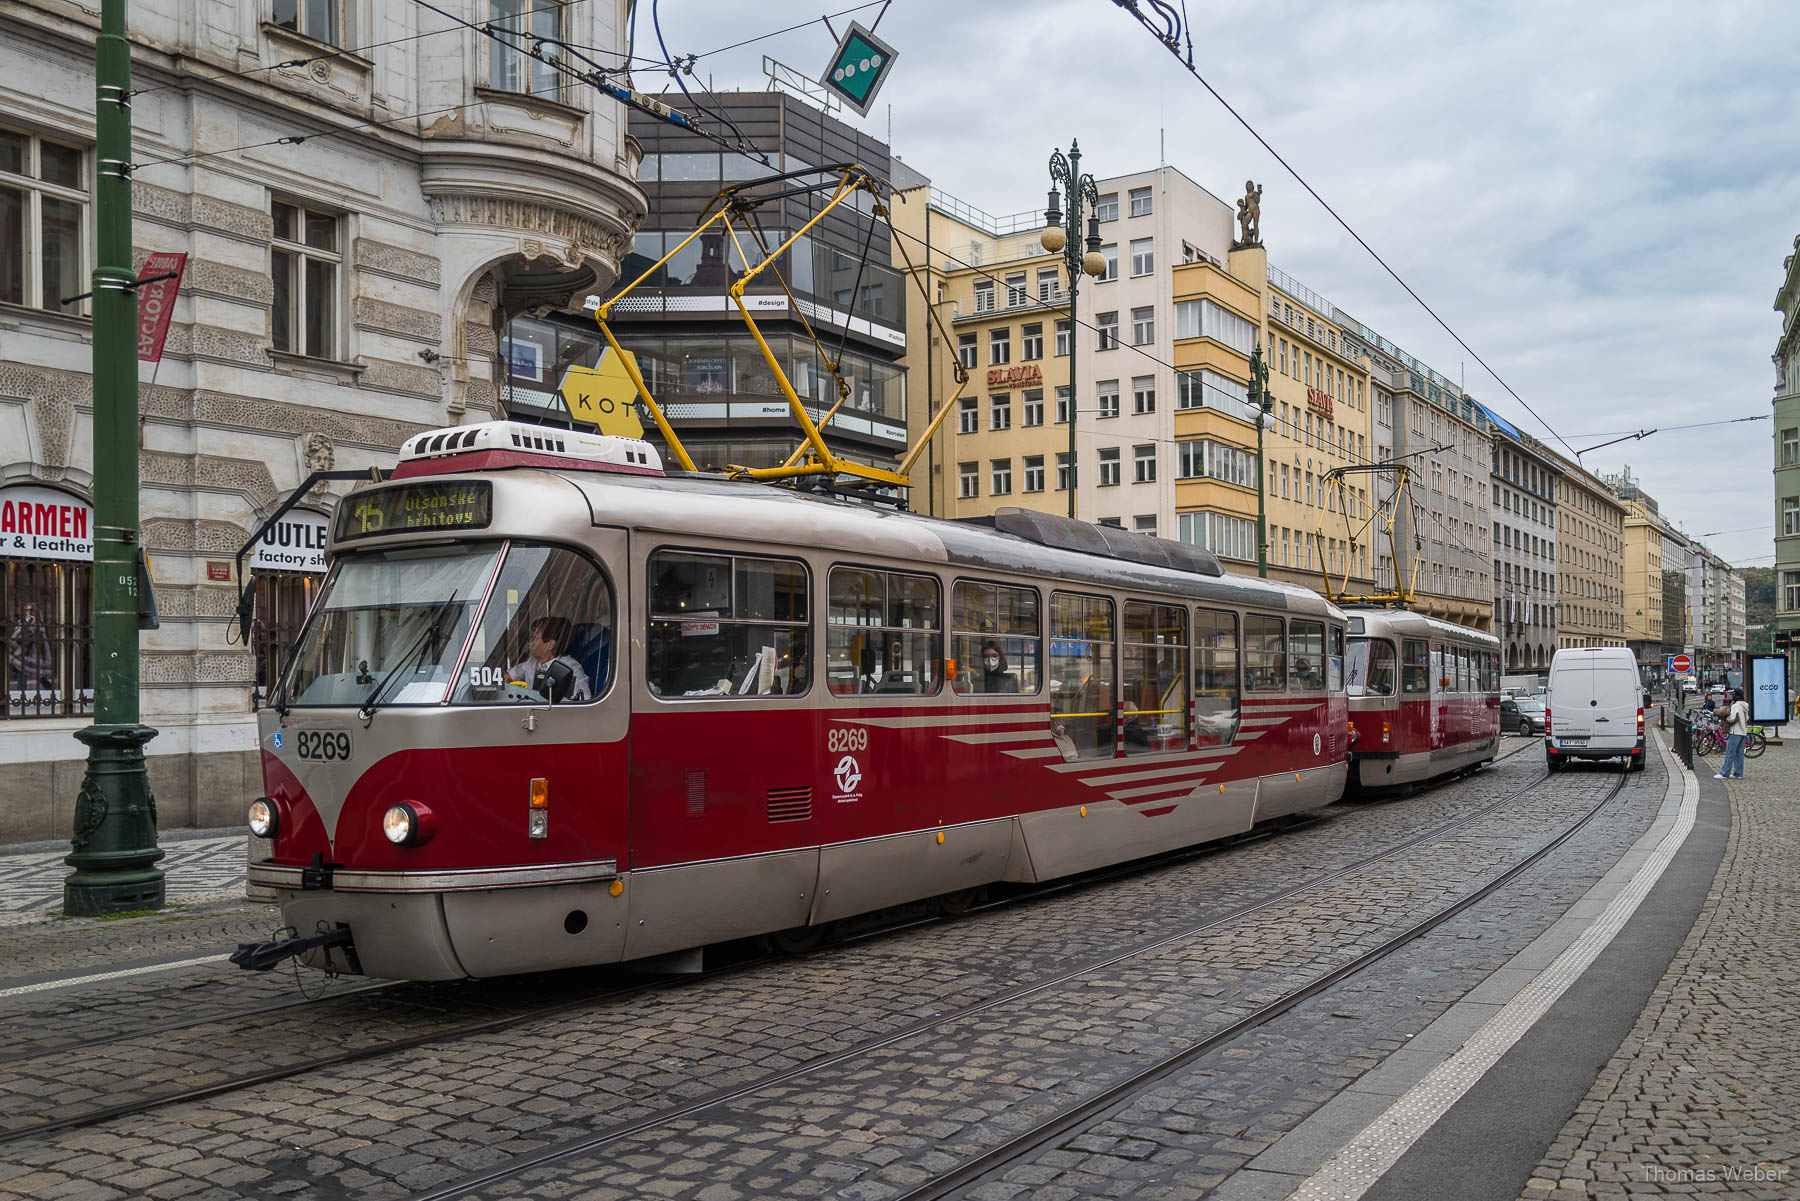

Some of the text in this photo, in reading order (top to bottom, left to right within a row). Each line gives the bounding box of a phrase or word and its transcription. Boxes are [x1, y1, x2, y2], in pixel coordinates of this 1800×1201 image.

[758, 299, 785, 307] #design
[987, 364, 1042, 385] SLAVIA
[1307, 387, 1334, 413] SLAVIA
[354, 499, 384, 533] 15
[13, 536, 26, 549] &
[33, 536, 93, 553] leather
[259, 550, 306, 567] factory
[470, 666, 504, 686] 504
[297, 731, 350, 761] 8269
[827, 728, 868, 752] 8269
